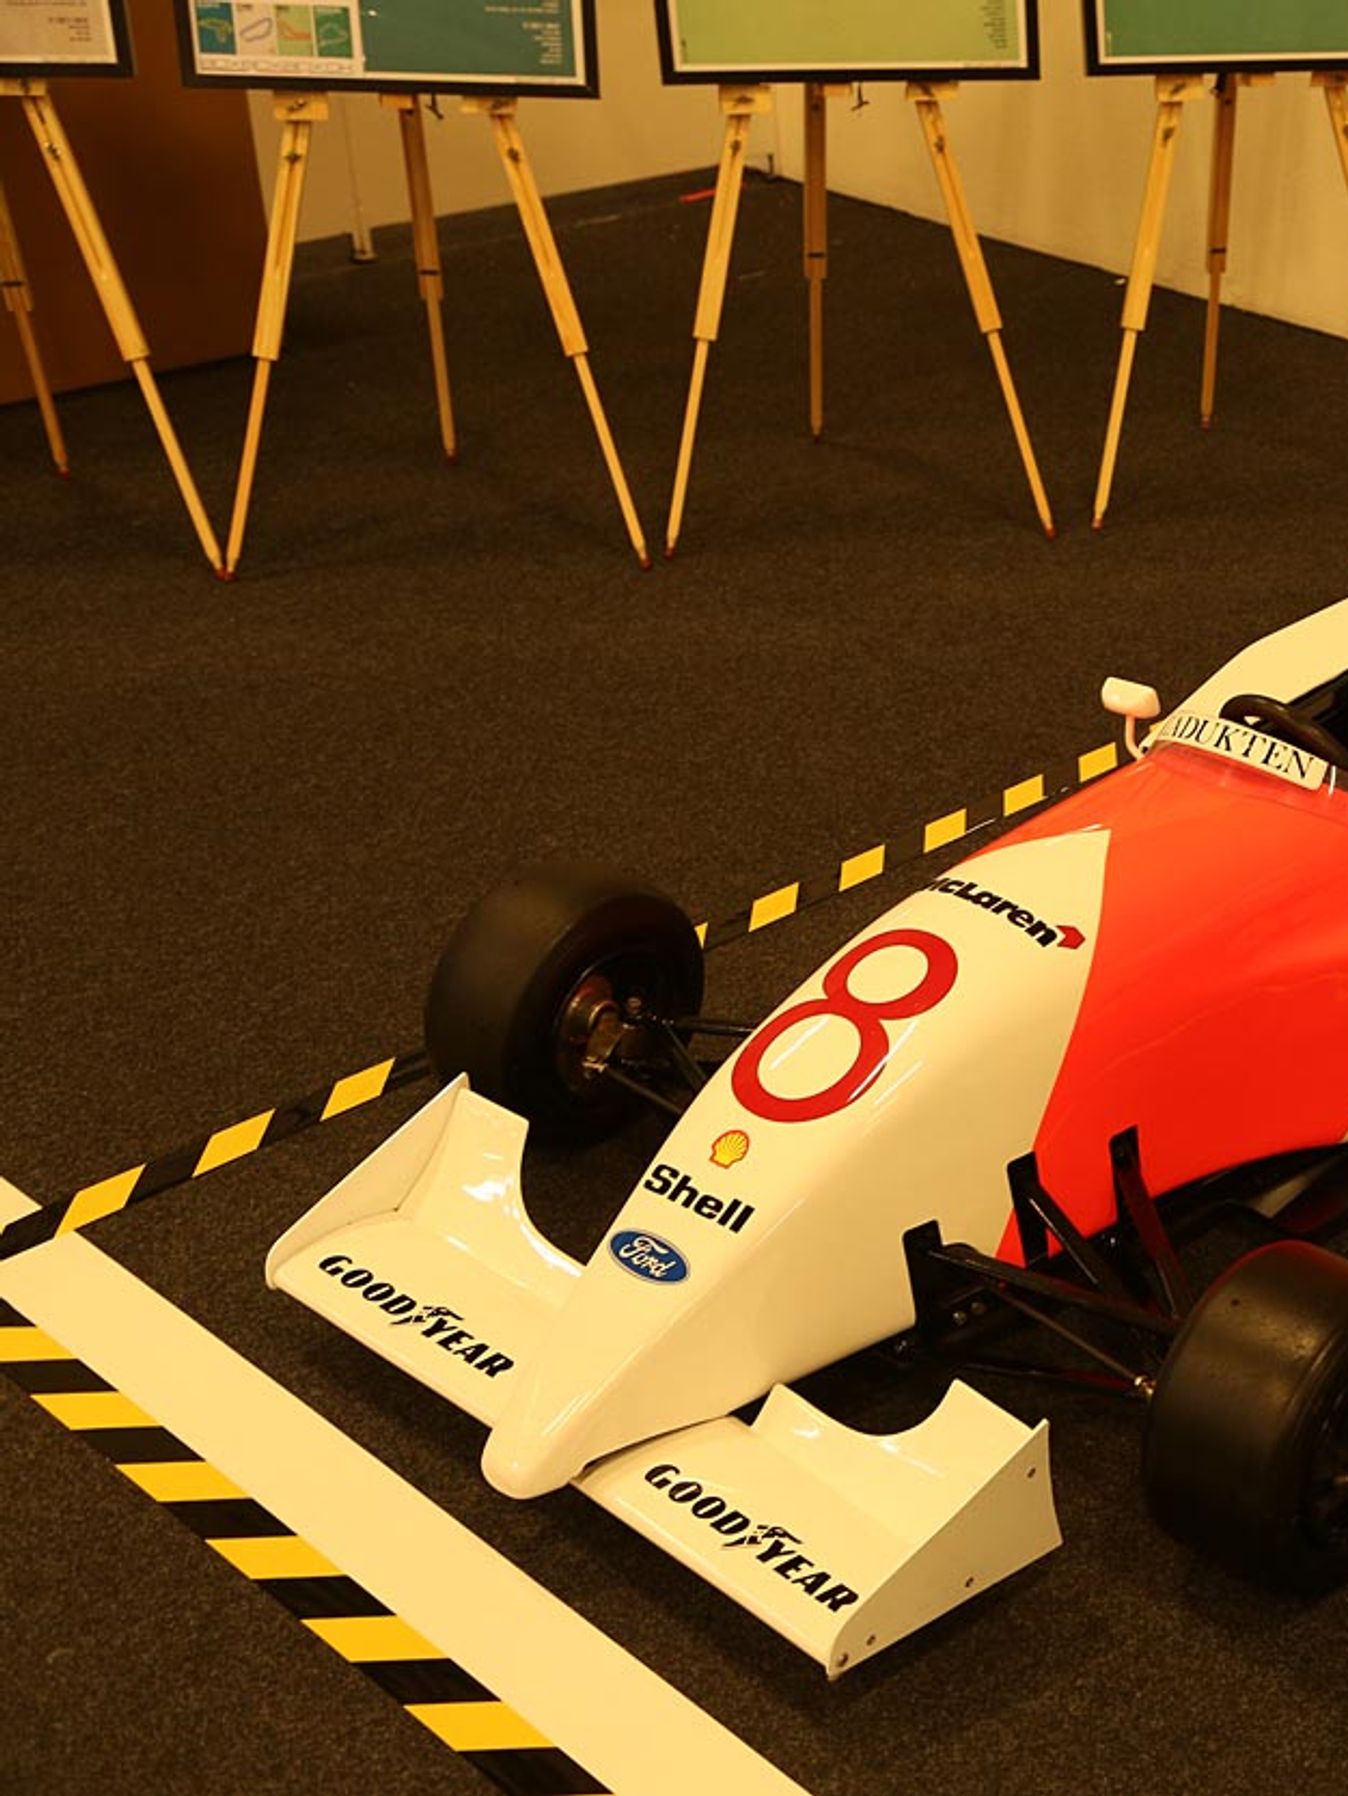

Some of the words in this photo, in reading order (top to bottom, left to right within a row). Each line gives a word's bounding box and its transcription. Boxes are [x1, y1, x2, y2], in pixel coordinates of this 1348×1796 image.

[731, 928, 958, 1124] 8
[643, 1164, 755, 1234] Shell
[619, 1235, 677, 1278] Ford
